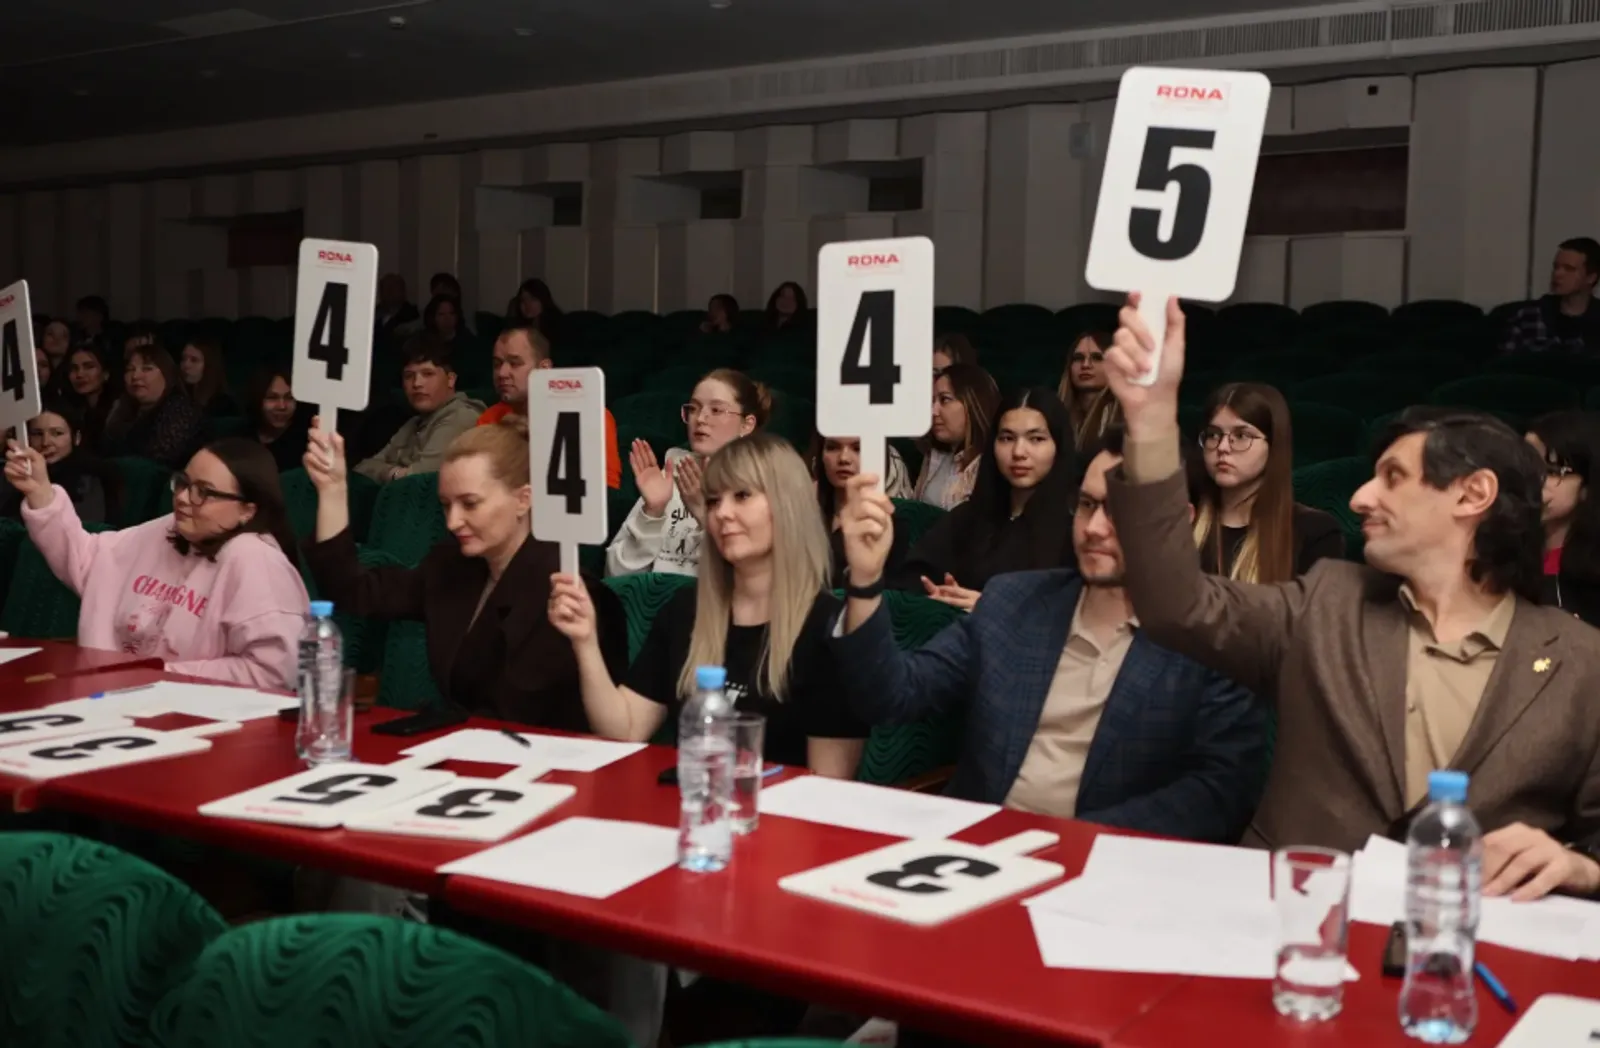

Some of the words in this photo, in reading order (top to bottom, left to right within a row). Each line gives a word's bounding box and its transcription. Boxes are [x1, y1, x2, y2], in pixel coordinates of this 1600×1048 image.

[1156, 84, 1224, 101] RONA
[1128, 126, 1216, 261] 5
[318, 250, 353, 263] RONA
[847, 253, 900, 266] RONA
[308, 281, 349, 381] 4
[840, 289, 901, 405] 4
[2, 318, 26, 401] 4
[548, 380, 582, 391] RONA
[547, 412, 587, 514] 4
[29, 736, 157, 760] 3
[270, 773, 398, 805] 5
[415, 788, 524, 819] 3
[865, 854, 1001, 893] 3
